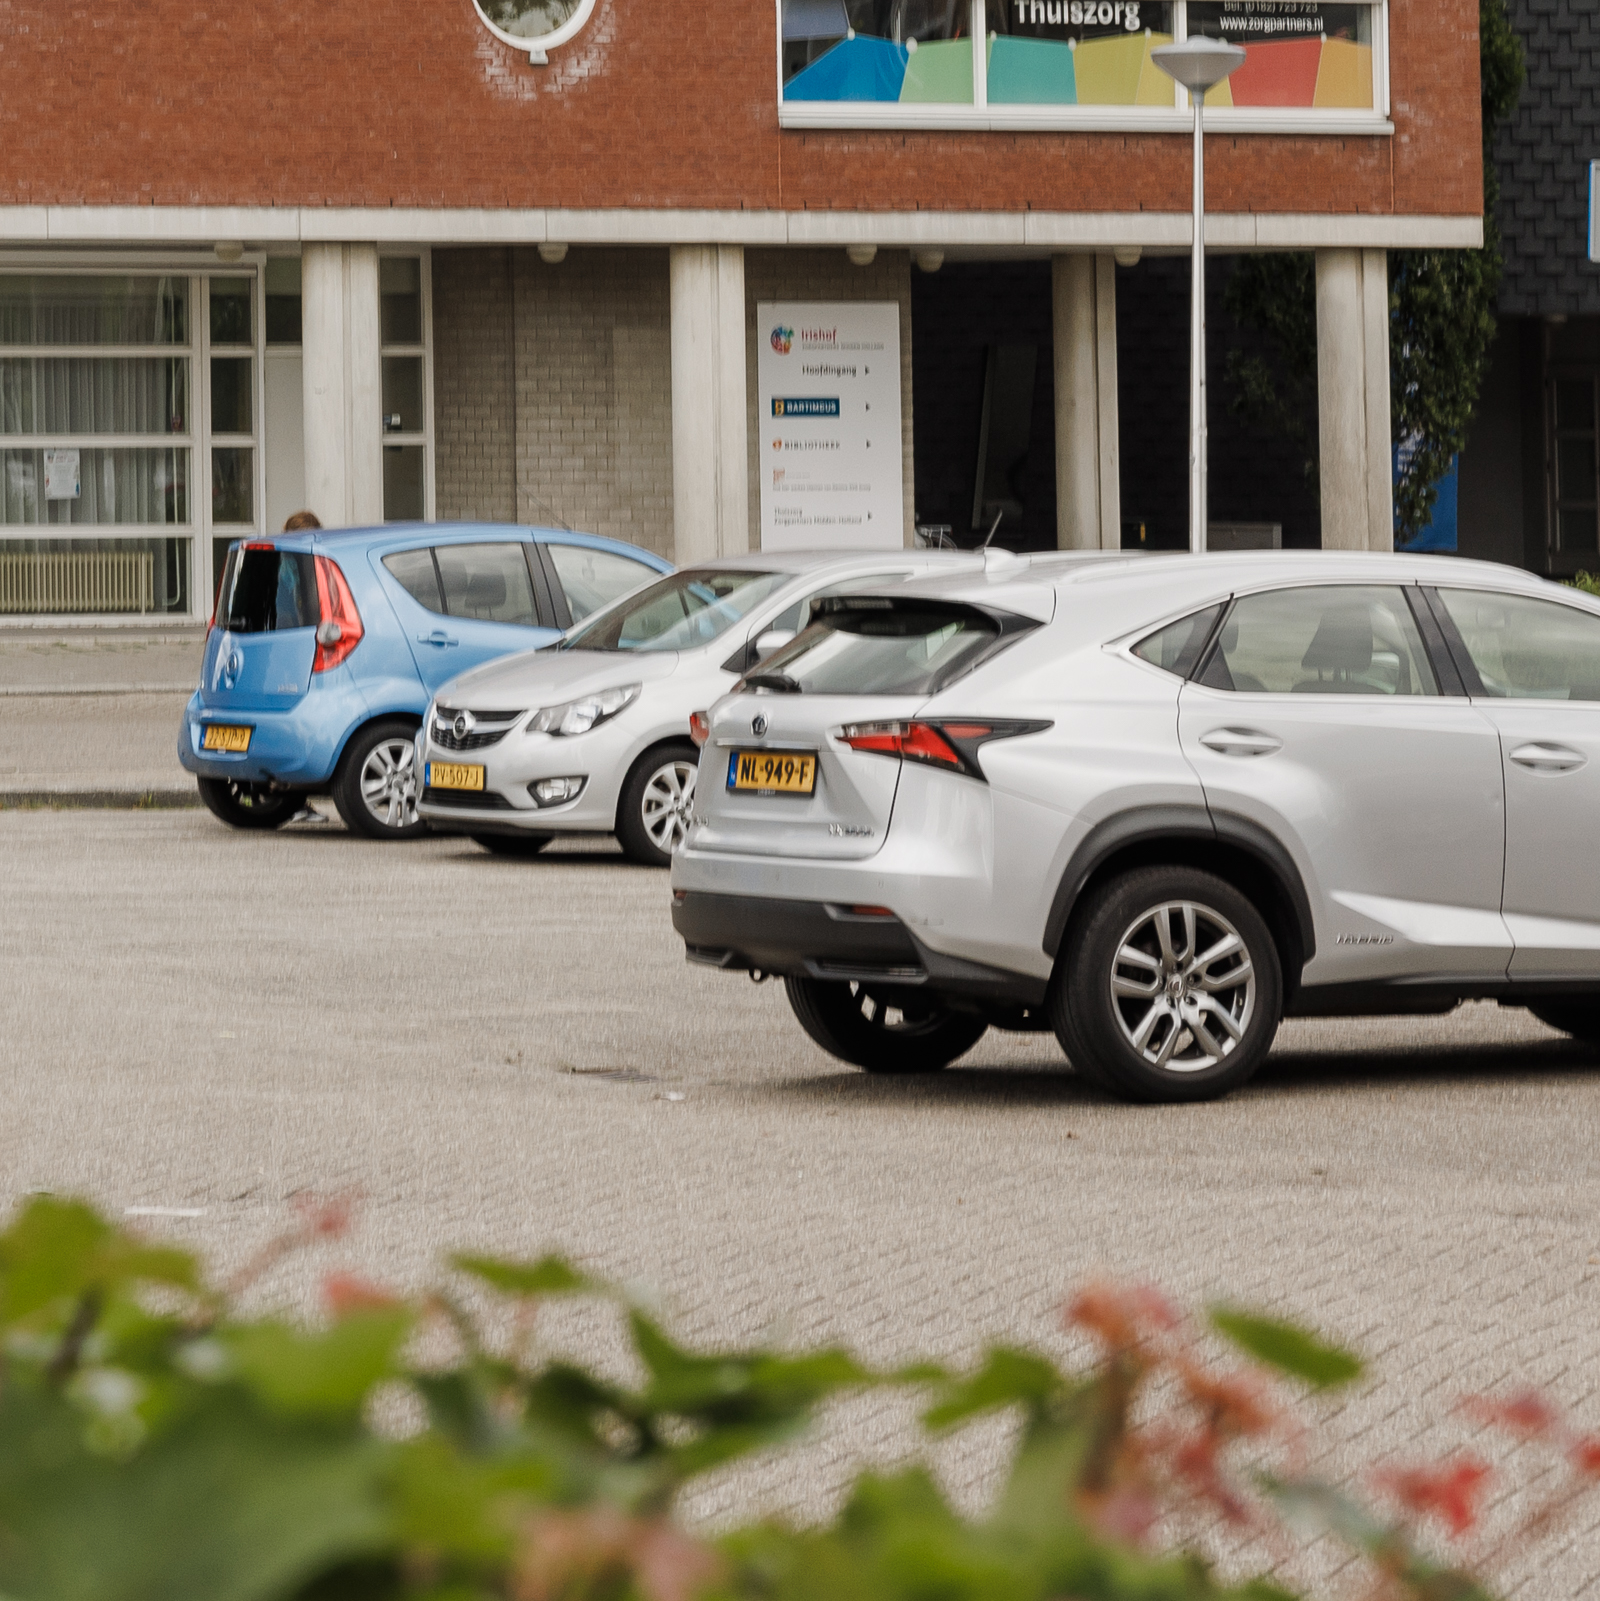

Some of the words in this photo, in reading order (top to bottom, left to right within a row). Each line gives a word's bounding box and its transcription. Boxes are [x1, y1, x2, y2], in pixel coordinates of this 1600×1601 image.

[1220, 16, 1323, 33] www.zorgpartners.nl
[801, 326, 837, 344] Irishof
[802, 362, 857, 378] Hoofdingang
[784, 439, 841, 451] BIBLIOTHEEK
[741, 757, 810, 786] NL-949-F
